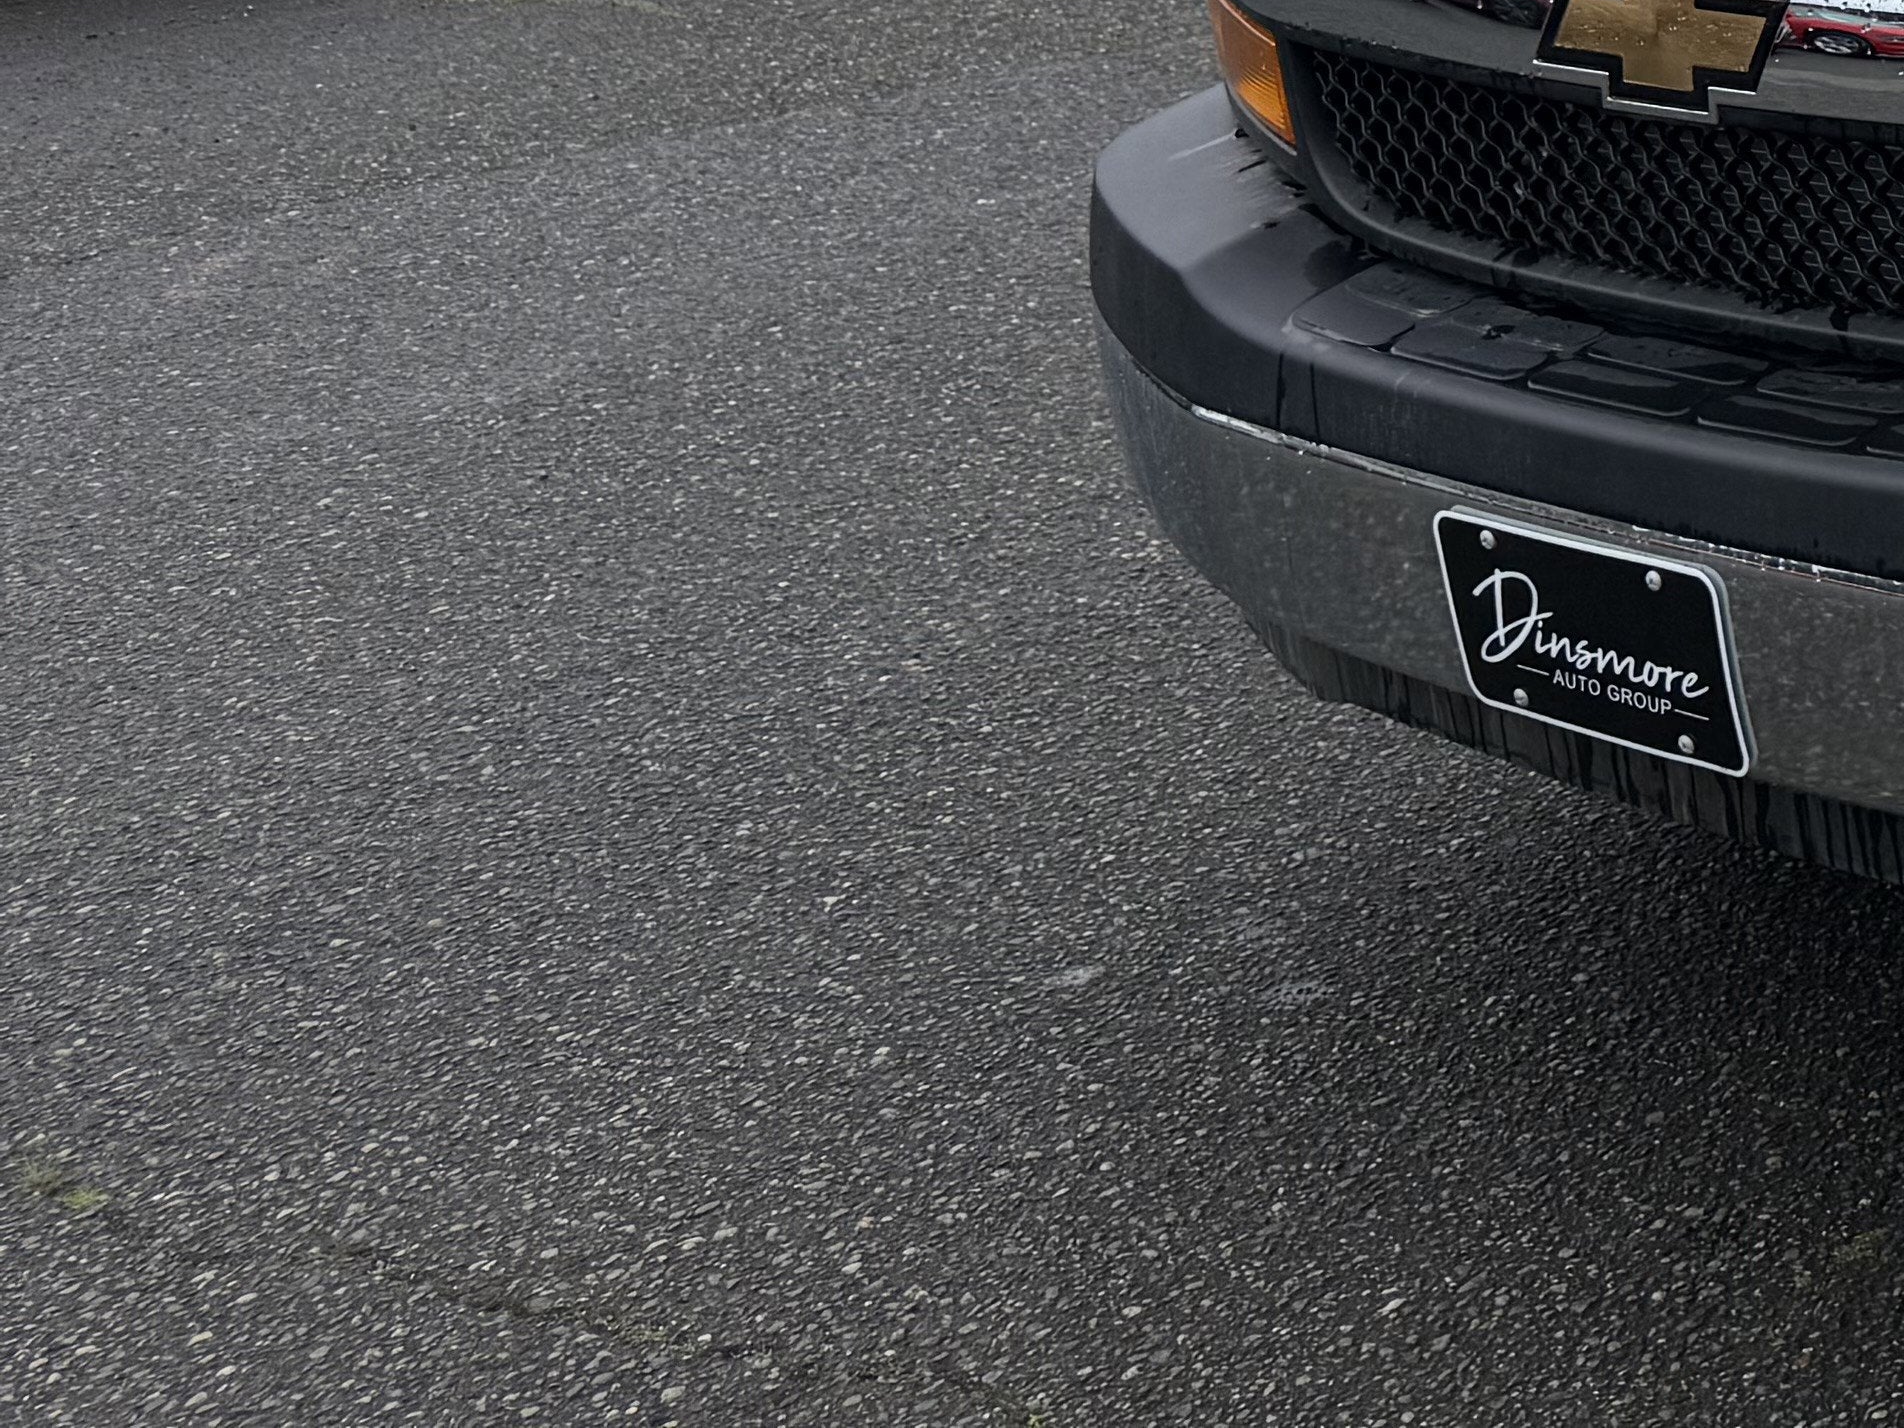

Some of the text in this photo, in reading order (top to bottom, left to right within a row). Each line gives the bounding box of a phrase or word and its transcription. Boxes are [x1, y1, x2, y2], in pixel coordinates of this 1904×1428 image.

[1472, 568, 1710, 699] Dinsmore
[1552, 668, 1673, 716] AUTO GROUP
